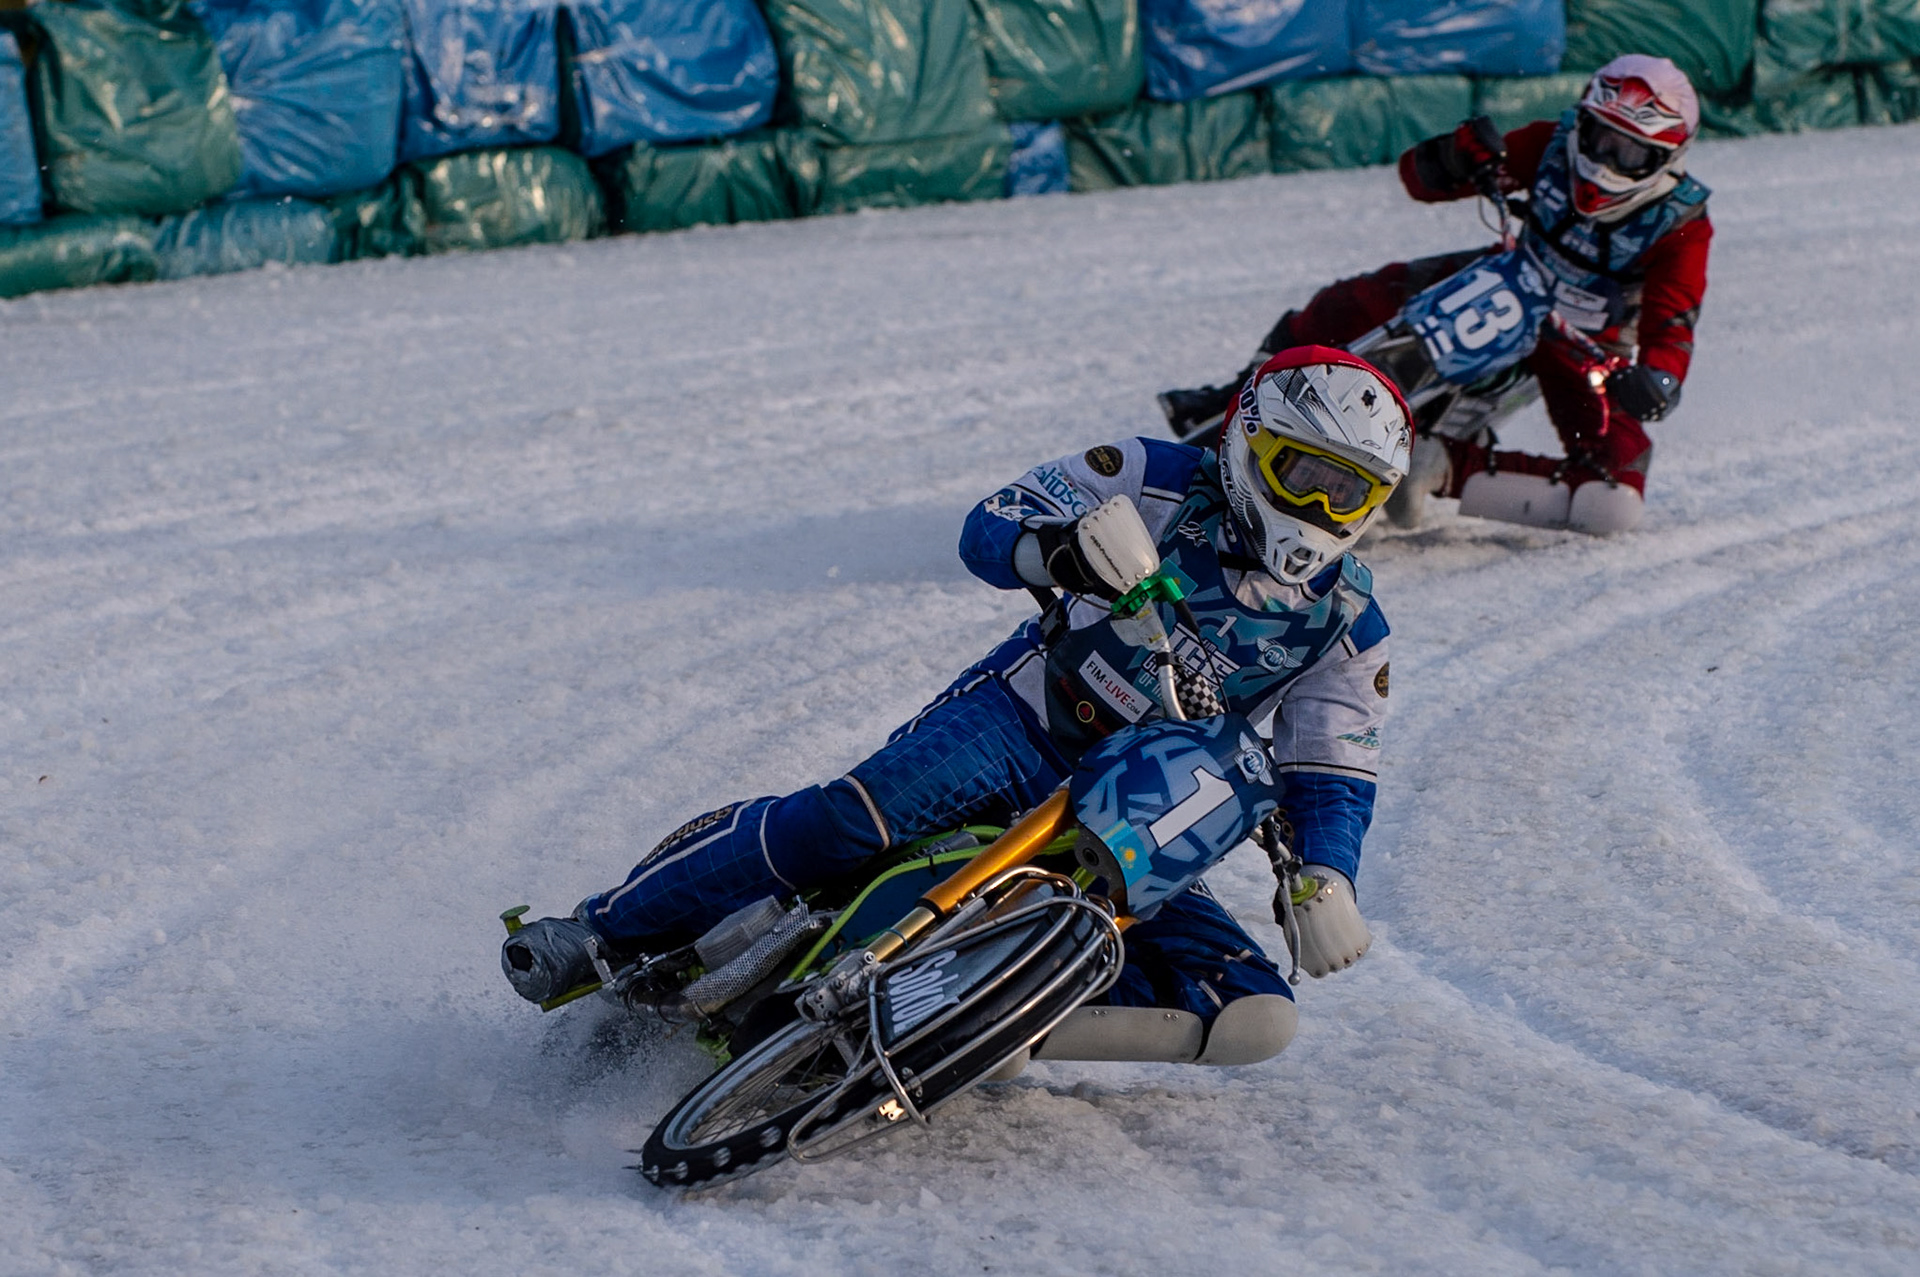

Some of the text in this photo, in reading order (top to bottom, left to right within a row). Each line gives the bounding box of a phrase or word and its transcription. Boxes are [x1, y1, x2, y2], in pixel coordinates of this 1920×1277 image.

[1438, 269, 1524, 351] 13
[1216, 614, 1238, 639] 1
[1266, 646, 1285, 664] FIM
[1245, 752, 1261, 775] FIM
[1149, 766, 1235, 849] 1
